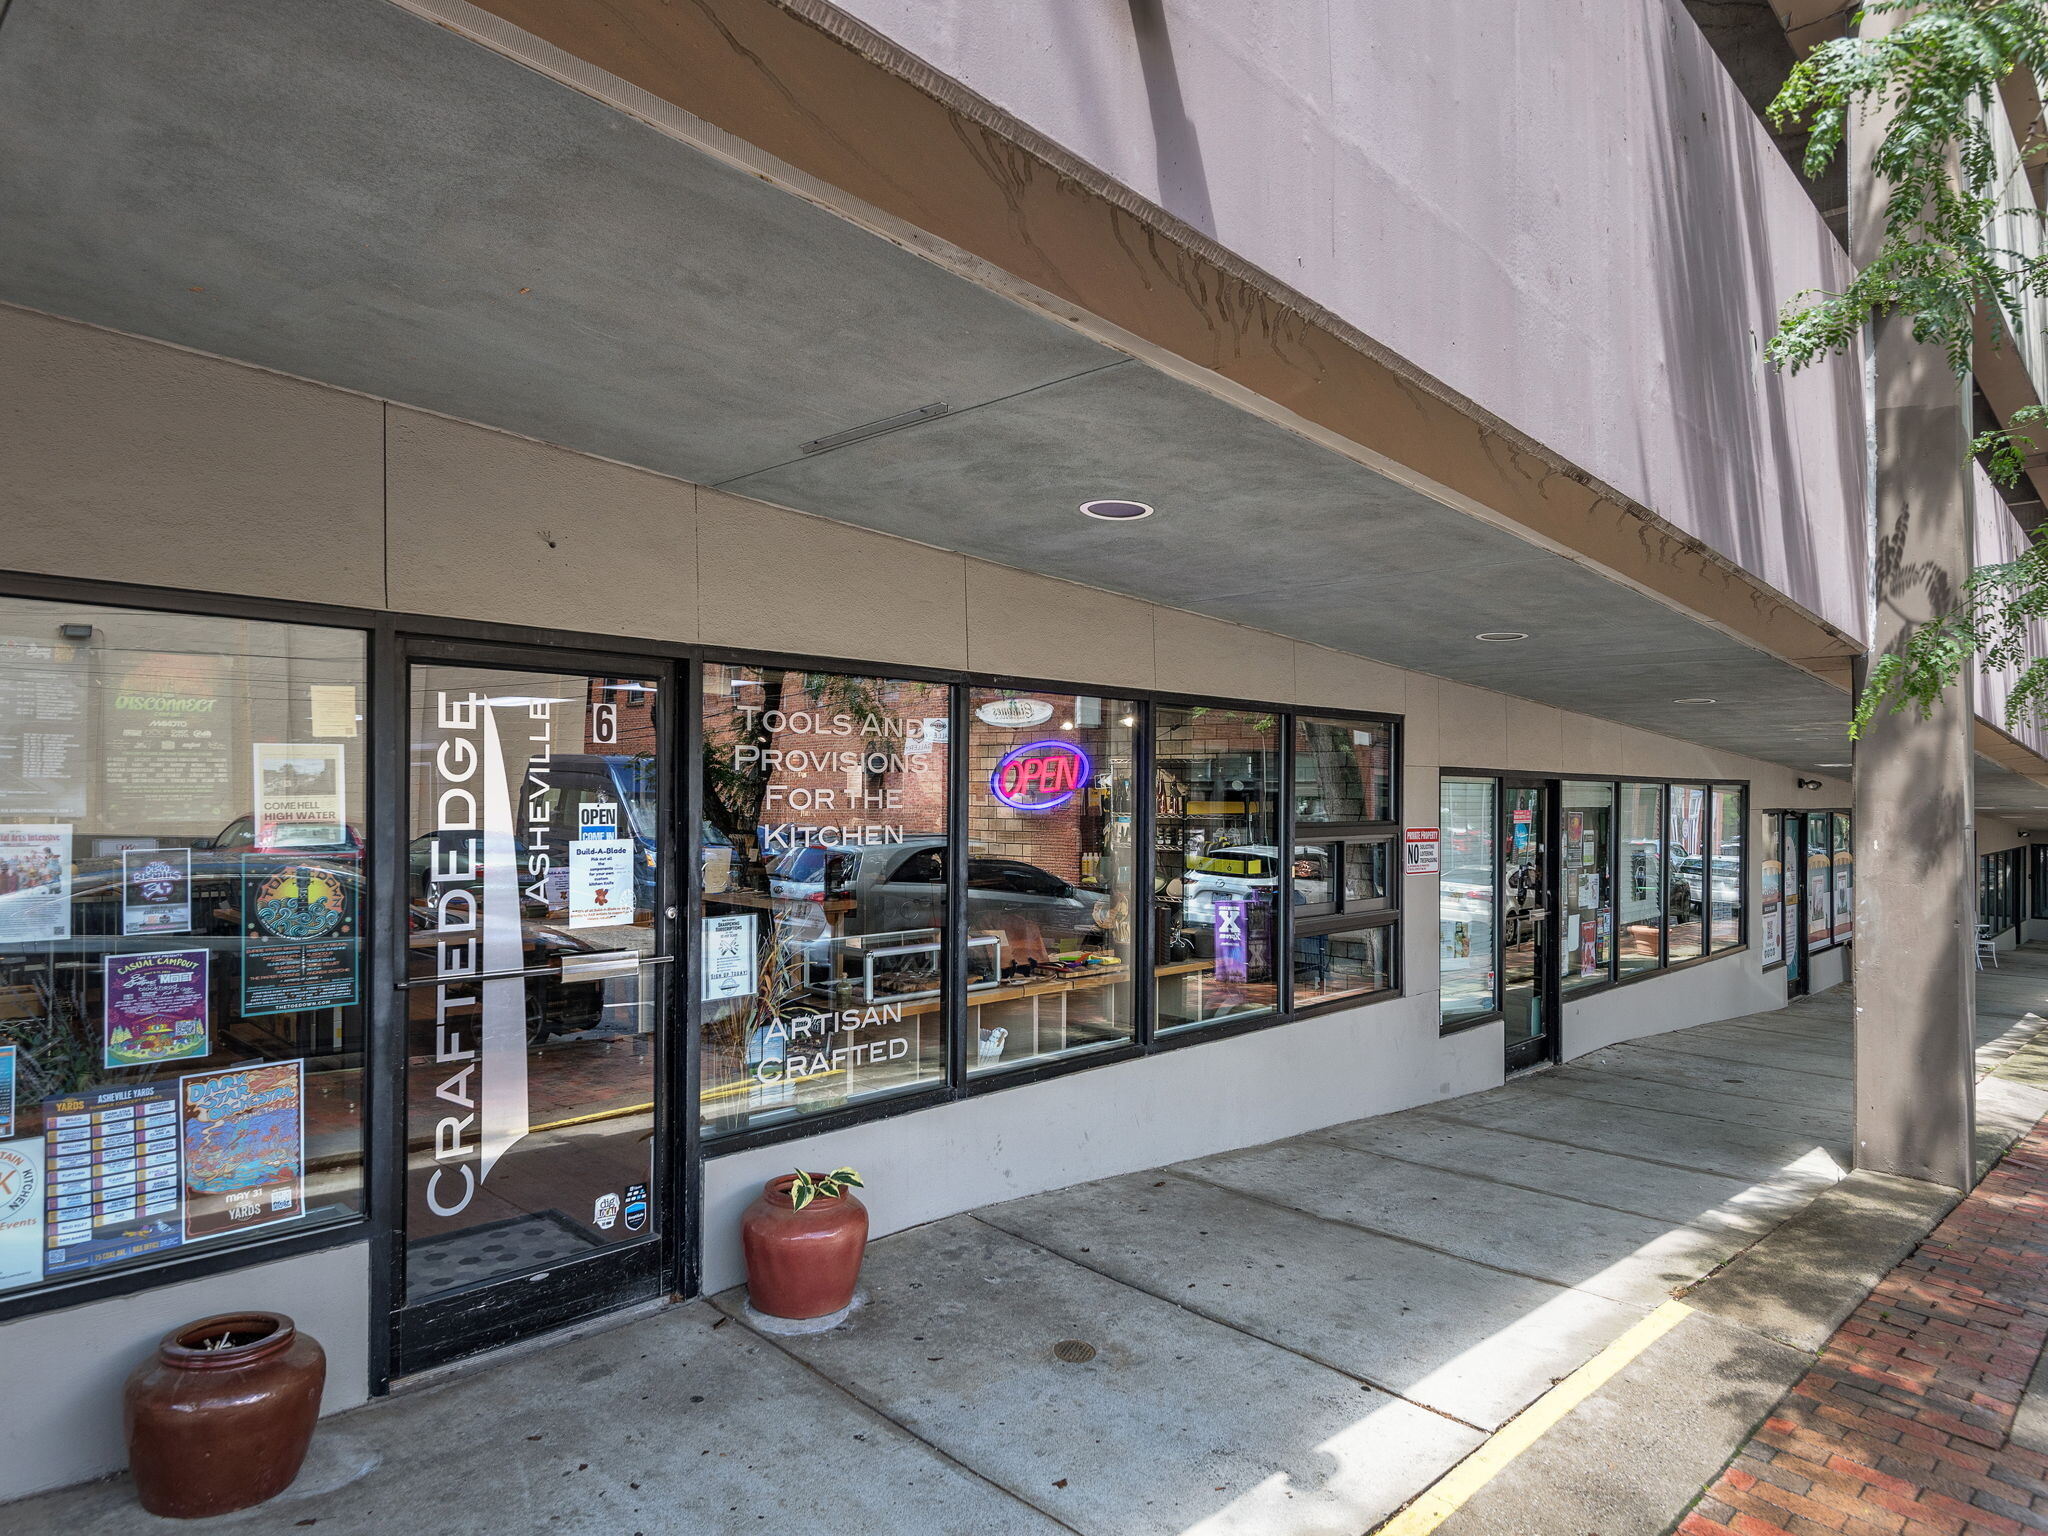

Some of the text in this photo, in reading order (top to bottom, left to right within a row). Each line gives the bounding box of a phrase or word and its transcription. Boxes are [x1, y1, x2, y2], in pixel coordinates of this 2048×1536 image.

[596, 704, 614, 742] 6
[737, 705, 926, 738] TOOLS AND
[734, 745, 928, 774] PROVISIONS
[1000, 754, 1081, 797] OPEN
[264, 801, 320, 810] COME HELL
[525, 699, 550, 904] ASHEVILLE
[766, 785, 903, 810] FOR THE
[264, 811, 336, 820] HIGH WATER
[581, 808, 616, 825] OPEN
[764, 823, 903, 849] KITCHEN
[576, 847, 627, 856] Build-A-Blade
[1408, 844, 1419, 864] NO
[117, 960, 155, 975] CASUAL
[157, 957, 200, 969] CAMPOUT
[427, 691, 478, 1217] CRAFTED EDGE
[764, 1003, 902, 1044] ARTISAN
[757, 1037, 909, 1085] CRAFTED
[97, 1086, 155, 1104] ASHEVILLE YARDS
[189, 1072, 249, 1103] DARK
[197, 1084, 251, 1110] STAR
[56, 1101, 85, 1112] YARDS
[208, 1085, 295, 1121] ORCHESTRA
[9, 1168, 34, 1211] KITCHEN
[225, 1188, 263, 1203] MAY 31
[228, 1203, 262, 1221] YARDS
[601, 1197, 616, 1209] dig
[0, 1218, 37, 1231] Events
